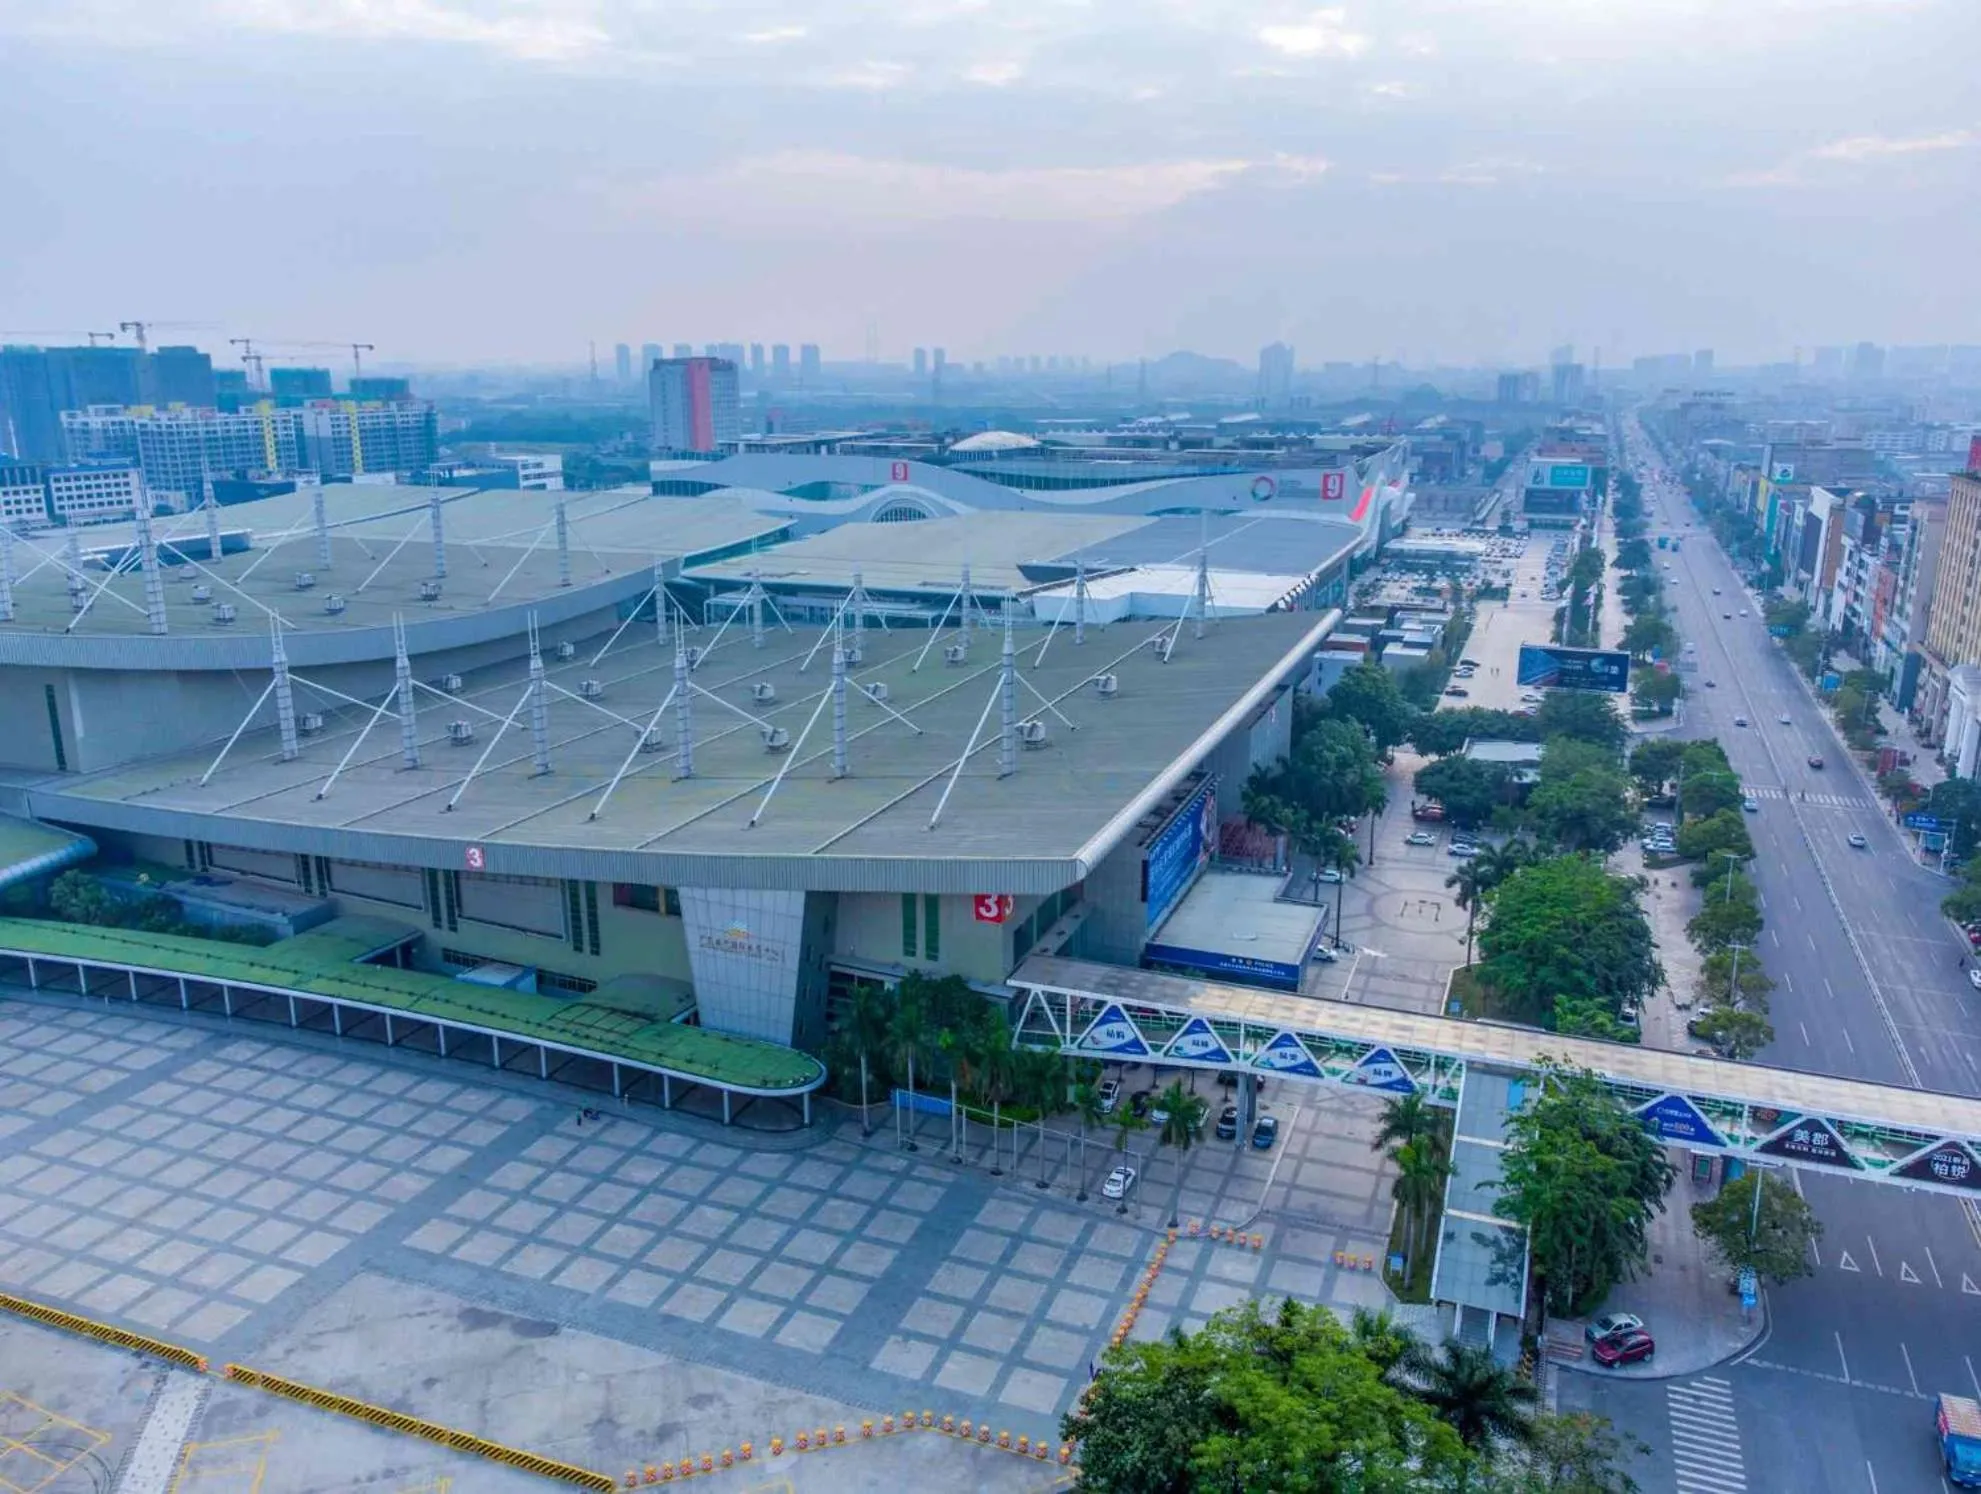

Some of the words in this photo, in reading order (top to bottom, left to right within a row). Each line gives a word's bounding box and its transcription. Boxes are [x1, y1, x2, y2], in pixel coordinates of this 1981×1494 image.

[1328, 474, 1340, 498] 9
[468, 847, 482, 867] 3
[978, 894, 999, 918] 3
